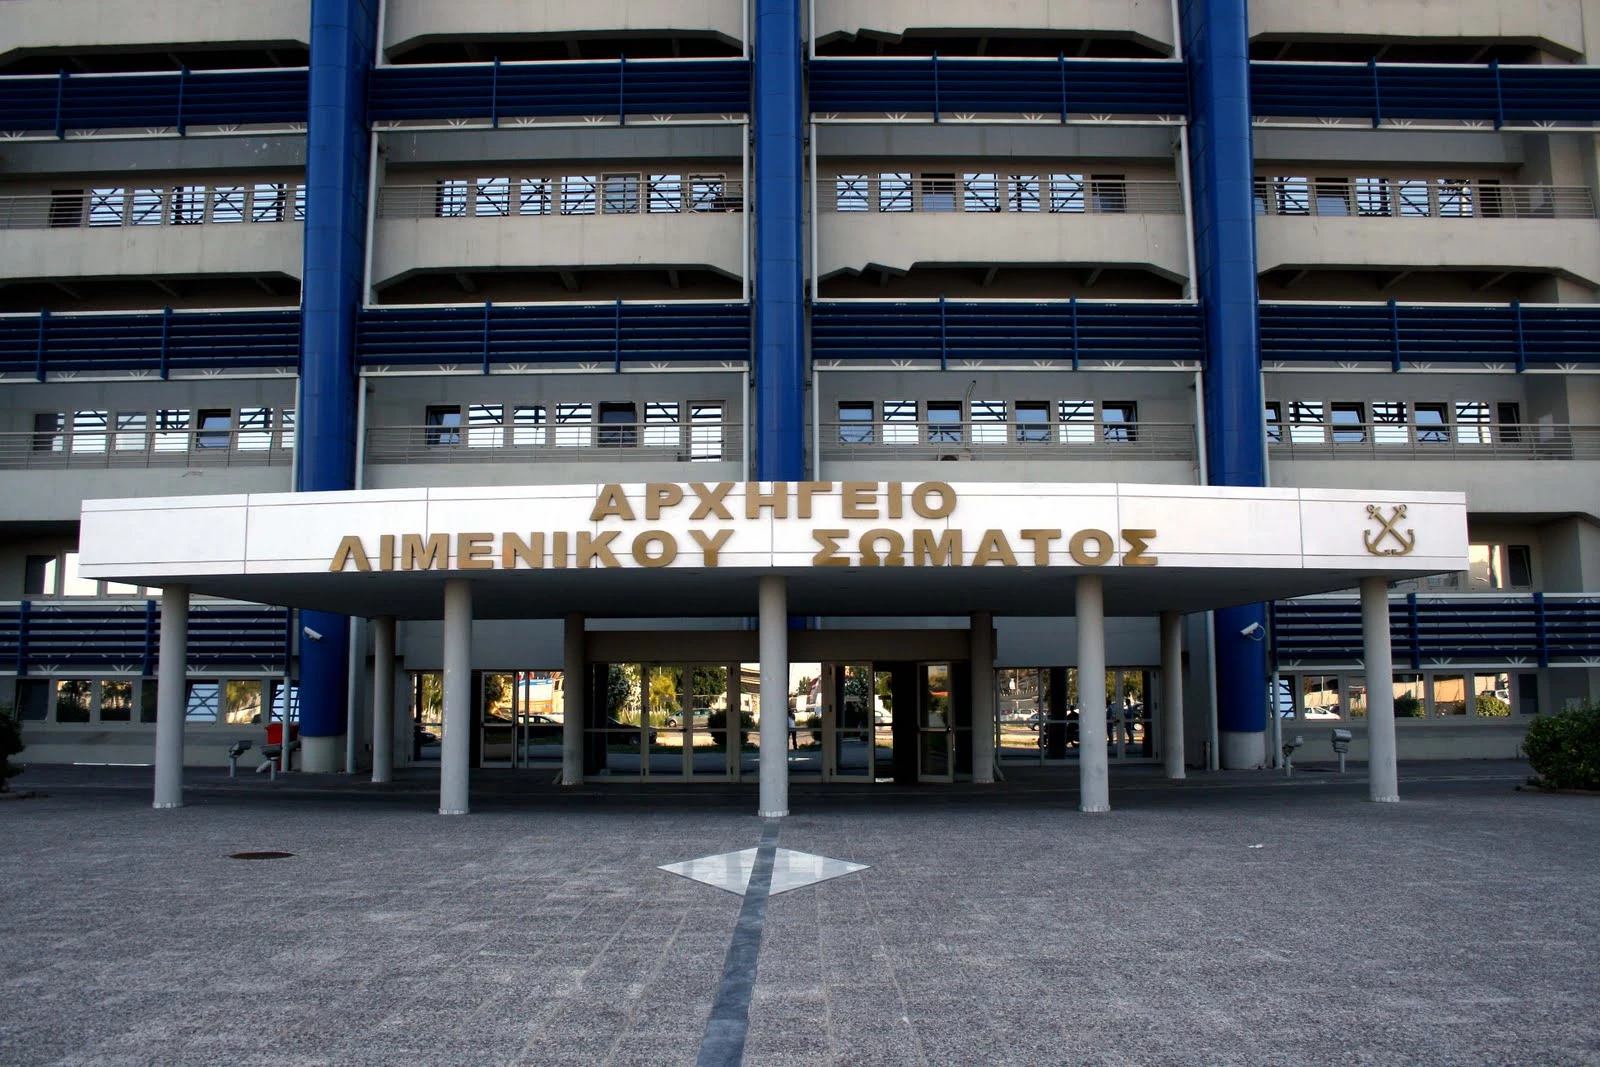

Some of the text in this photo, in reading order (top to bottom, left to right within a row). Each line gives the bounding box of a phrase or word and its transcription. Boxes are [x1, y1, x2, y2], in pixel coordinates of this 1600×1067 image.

[590, 481, 956, 520] ΑΡΧΗΓΕΙΟ
[330, 529, 1158, 571] ΛΙΜΕΝΙΚΟΥ ΣΩΜΑΤΟΣ
